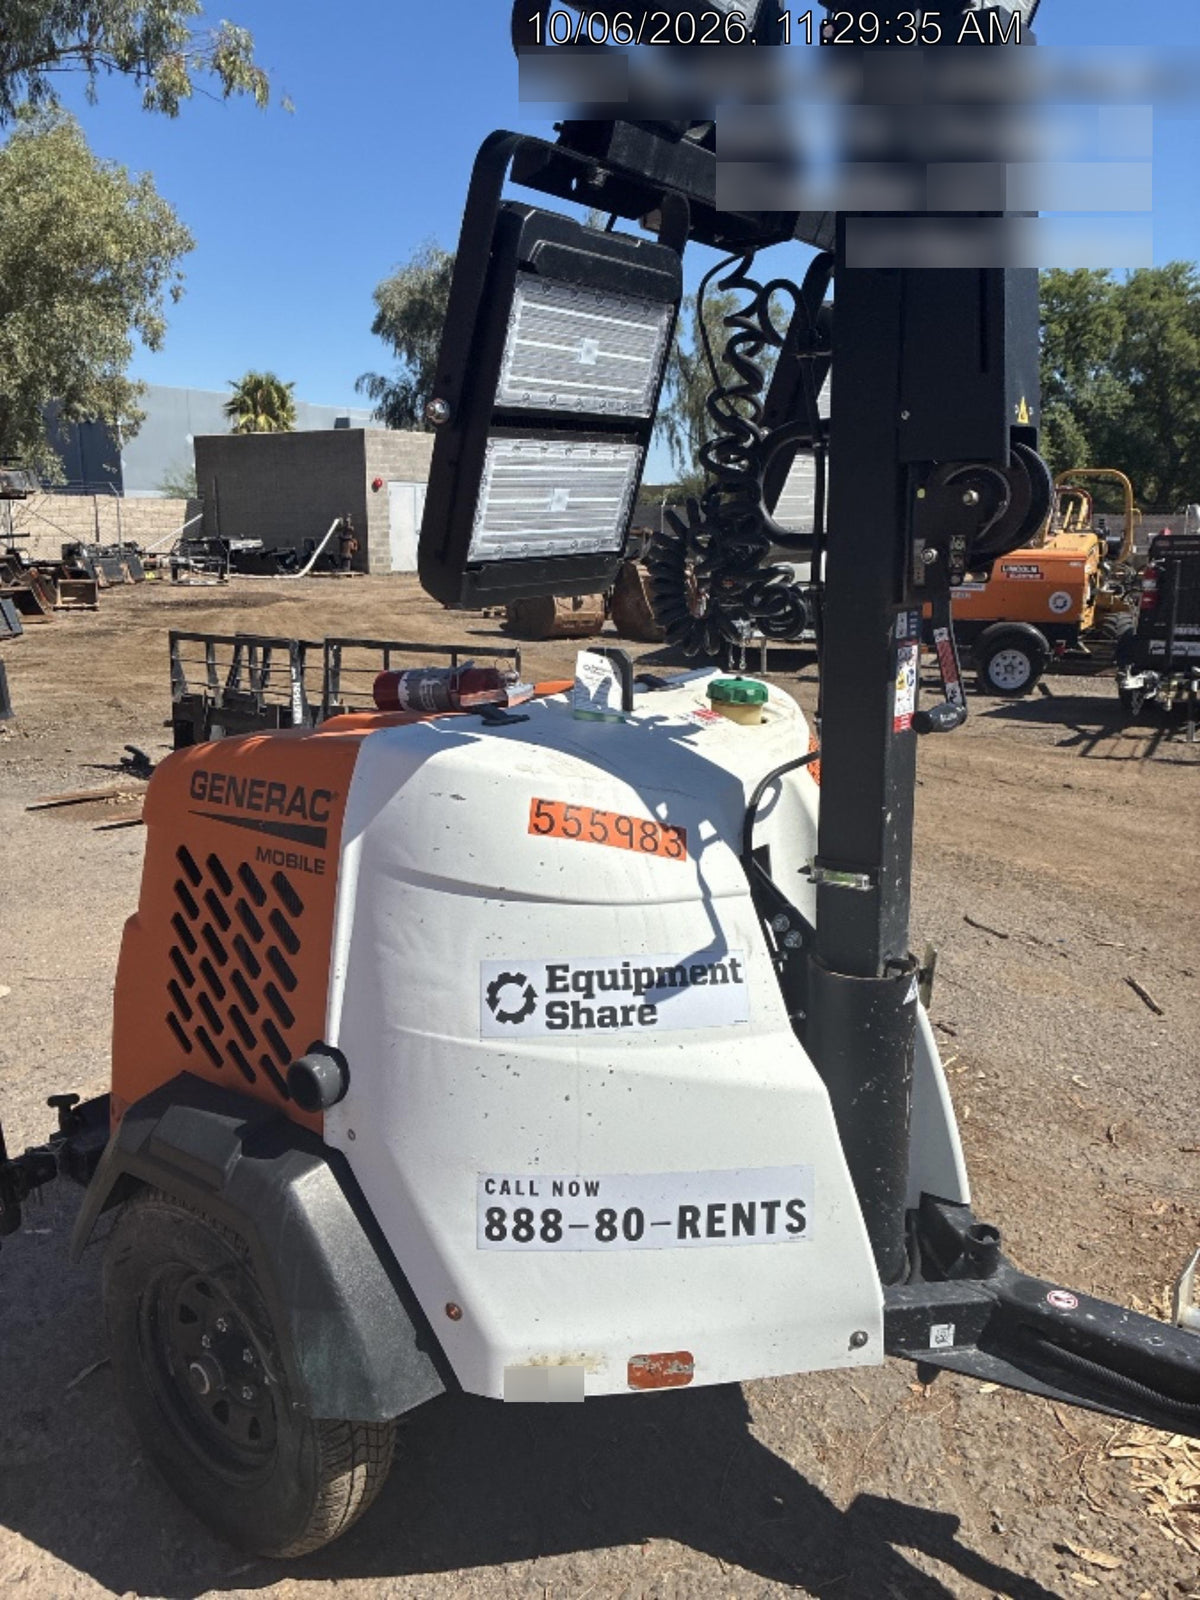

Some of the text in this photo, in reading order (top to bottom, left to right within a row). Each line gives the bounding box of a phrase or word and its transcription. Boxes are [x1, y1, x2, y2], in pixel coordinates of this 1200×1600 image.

[189, 769, 331, 822] GENERAC
[532, 799, 682, 858] 555983
[255, 846, 326, 875] MOBILE
[545, 957, 743, 999] Equipment
[545, 1001, 657, 1030] Share
[484, 1179, 601, 1197] CALL NOW
[484, 1199, 806, 1243] 888-80-RENTS
